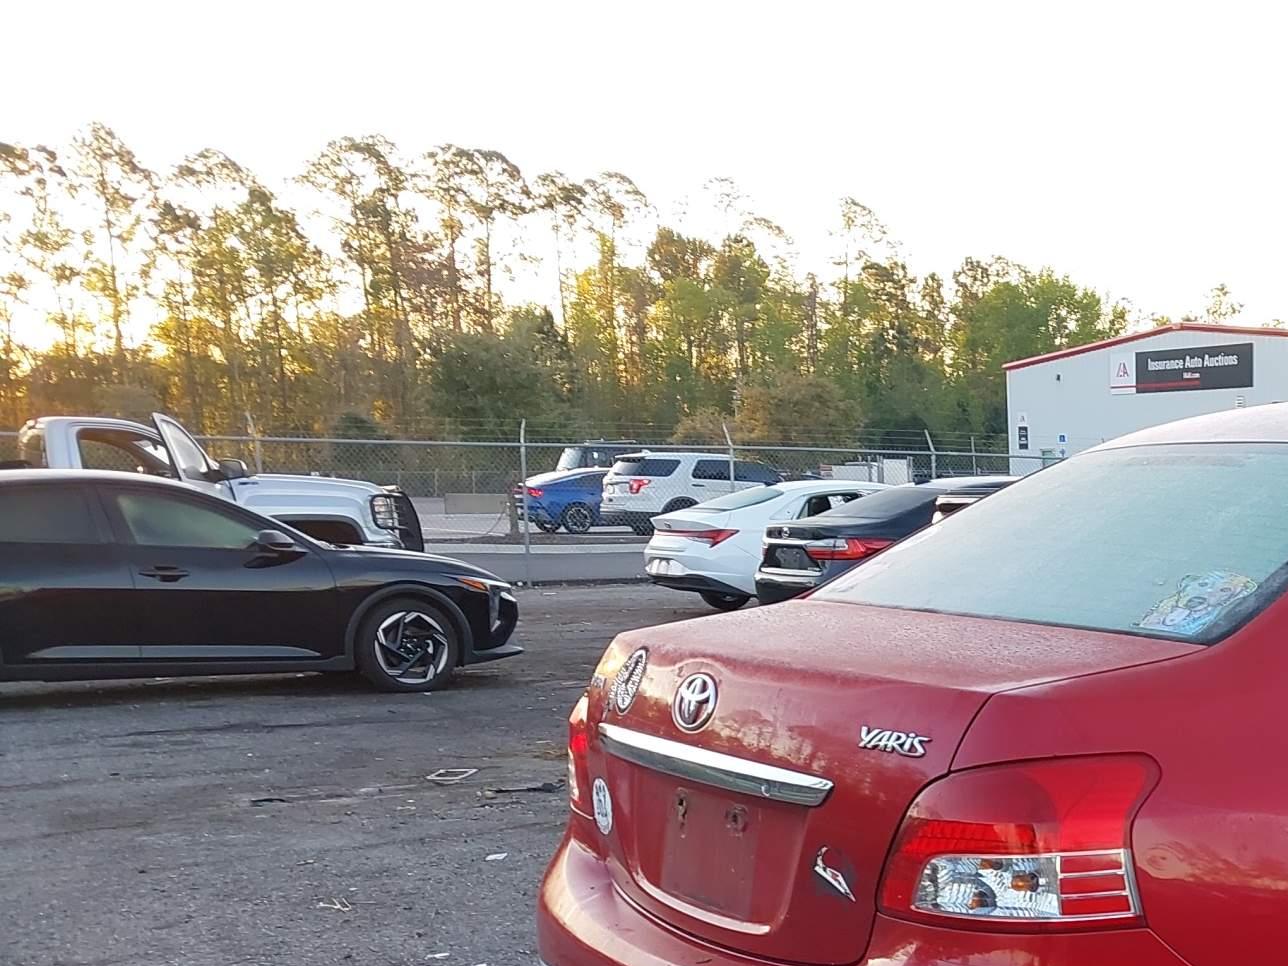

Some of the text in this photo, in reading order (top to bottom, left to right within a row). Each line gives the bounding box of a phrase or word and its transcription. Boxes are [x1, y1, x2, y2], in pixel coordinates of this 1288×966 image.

[1148, 352, 1238, 371] Insurance Auto Auctions
